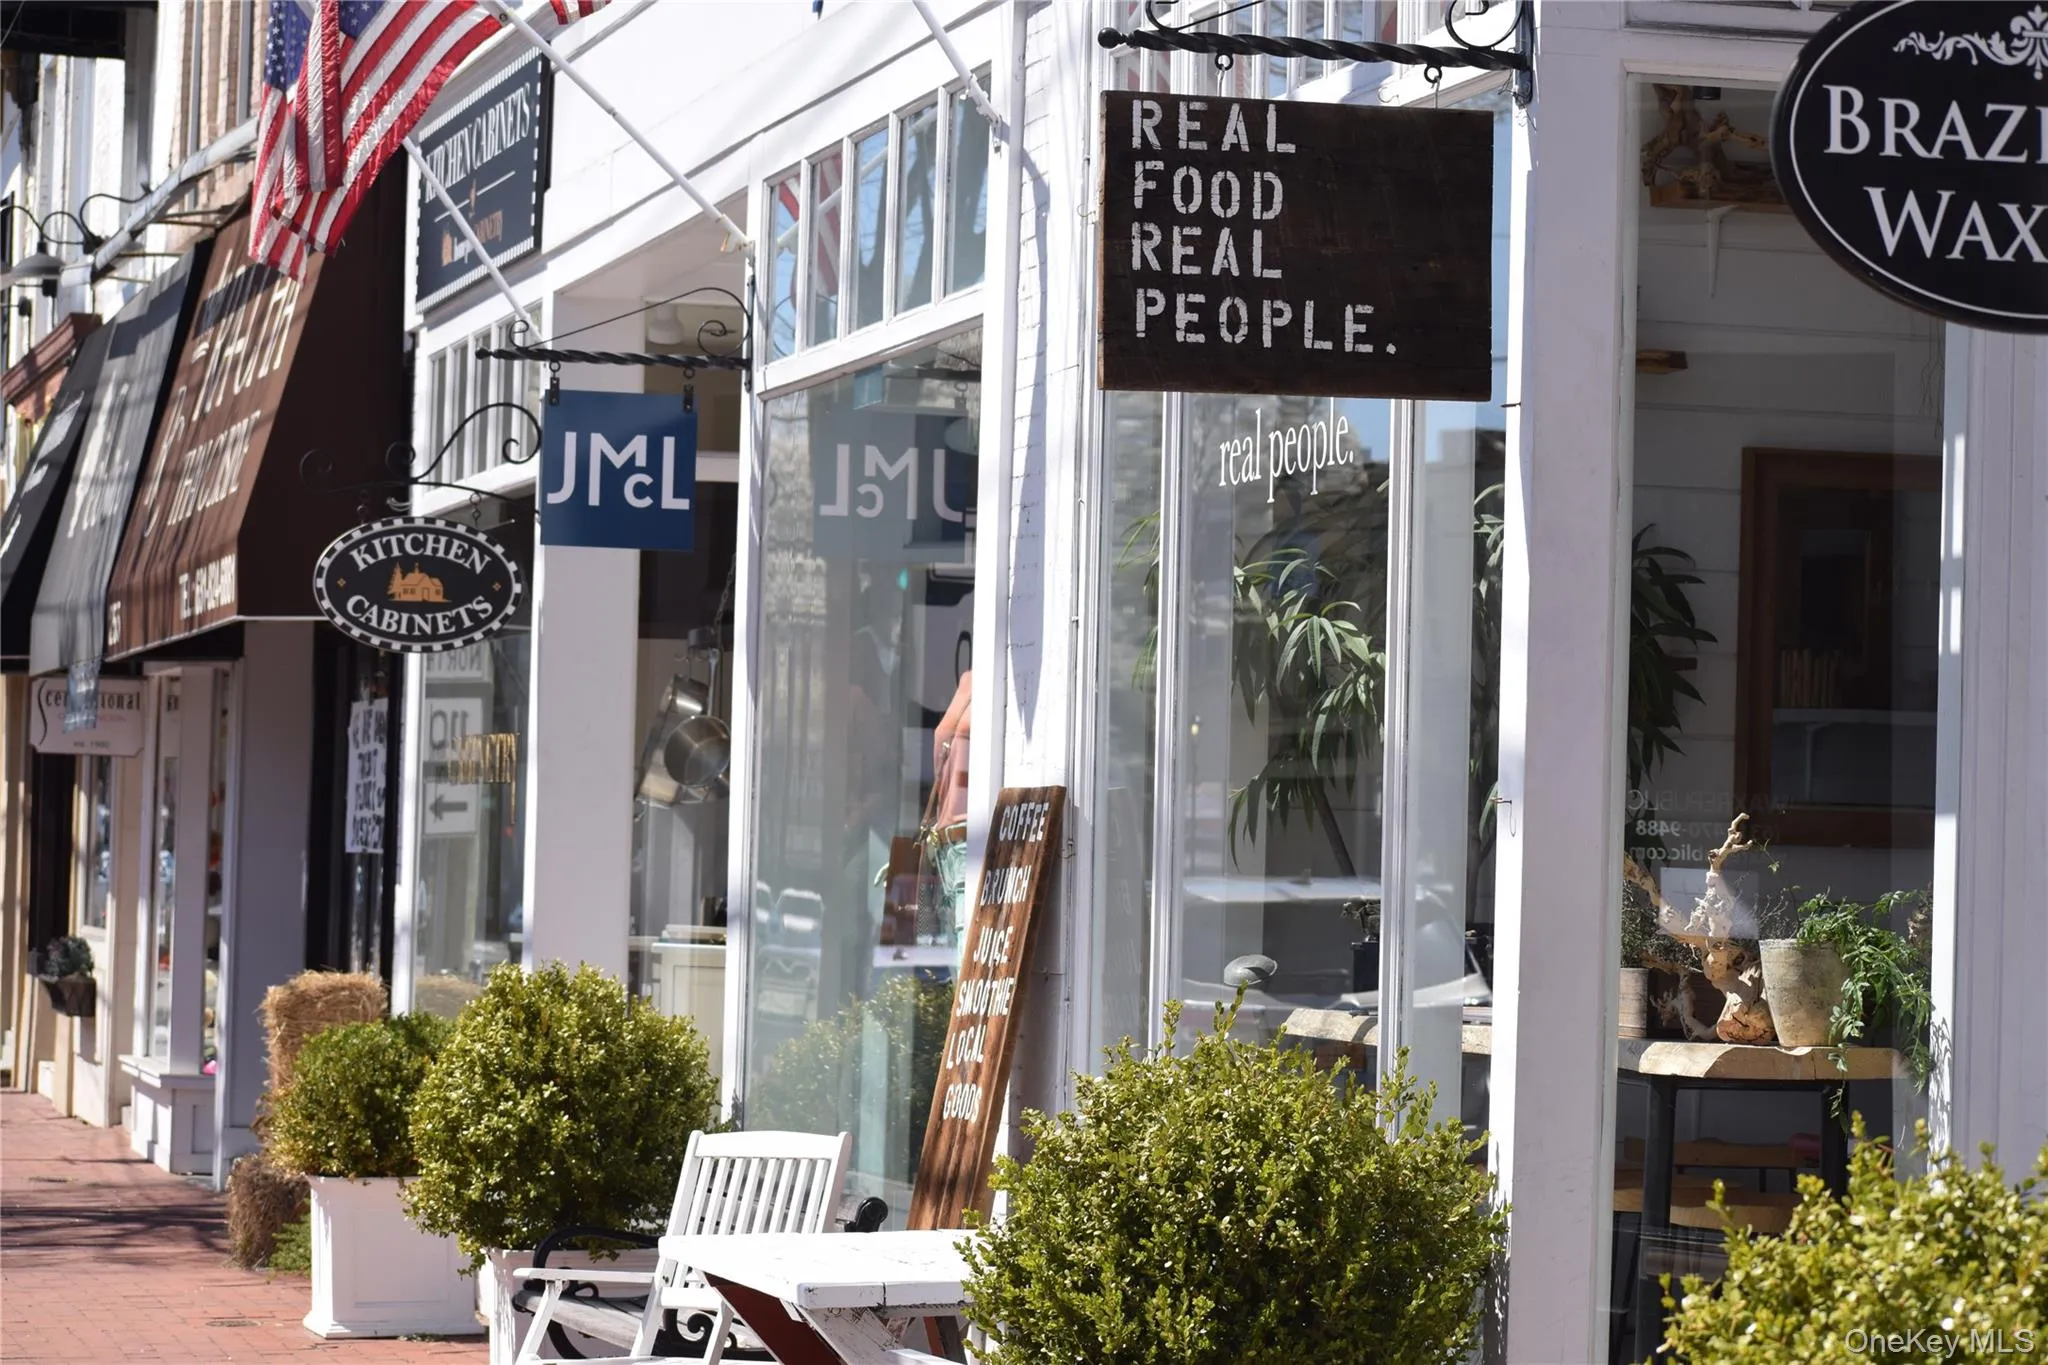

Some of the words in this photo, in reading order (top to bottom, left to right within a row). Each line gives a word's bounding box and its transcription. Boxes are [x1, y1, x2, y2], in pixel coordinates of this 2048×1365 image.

[472, 83, 531, 170] CABINETS
[1131, 99, 1296, 153] REAL
[1133, 160, 1284, 220] FOOD
[1131, 221, 1282, 279] REAL
[1135, 288, 1397, 354] PEOPLE.
[1219, 408, 1262, 487] real
[1267, 397, 1354, 503] people.
[349, 532, 492, 575] KITCHEN
[346, 594, 493, 636] CABINETS
[998, 802, 1049, 844] COFFEE
[980, 864, 1031, 907] BRUNCH
[973, 925, 1014, 969] JUICE
[955, 976, 1015, 1018] SMOOTHIE
[945, 1023, 989, 1071] LOCAL
[941, 1082, 983, 1123] GOODS
